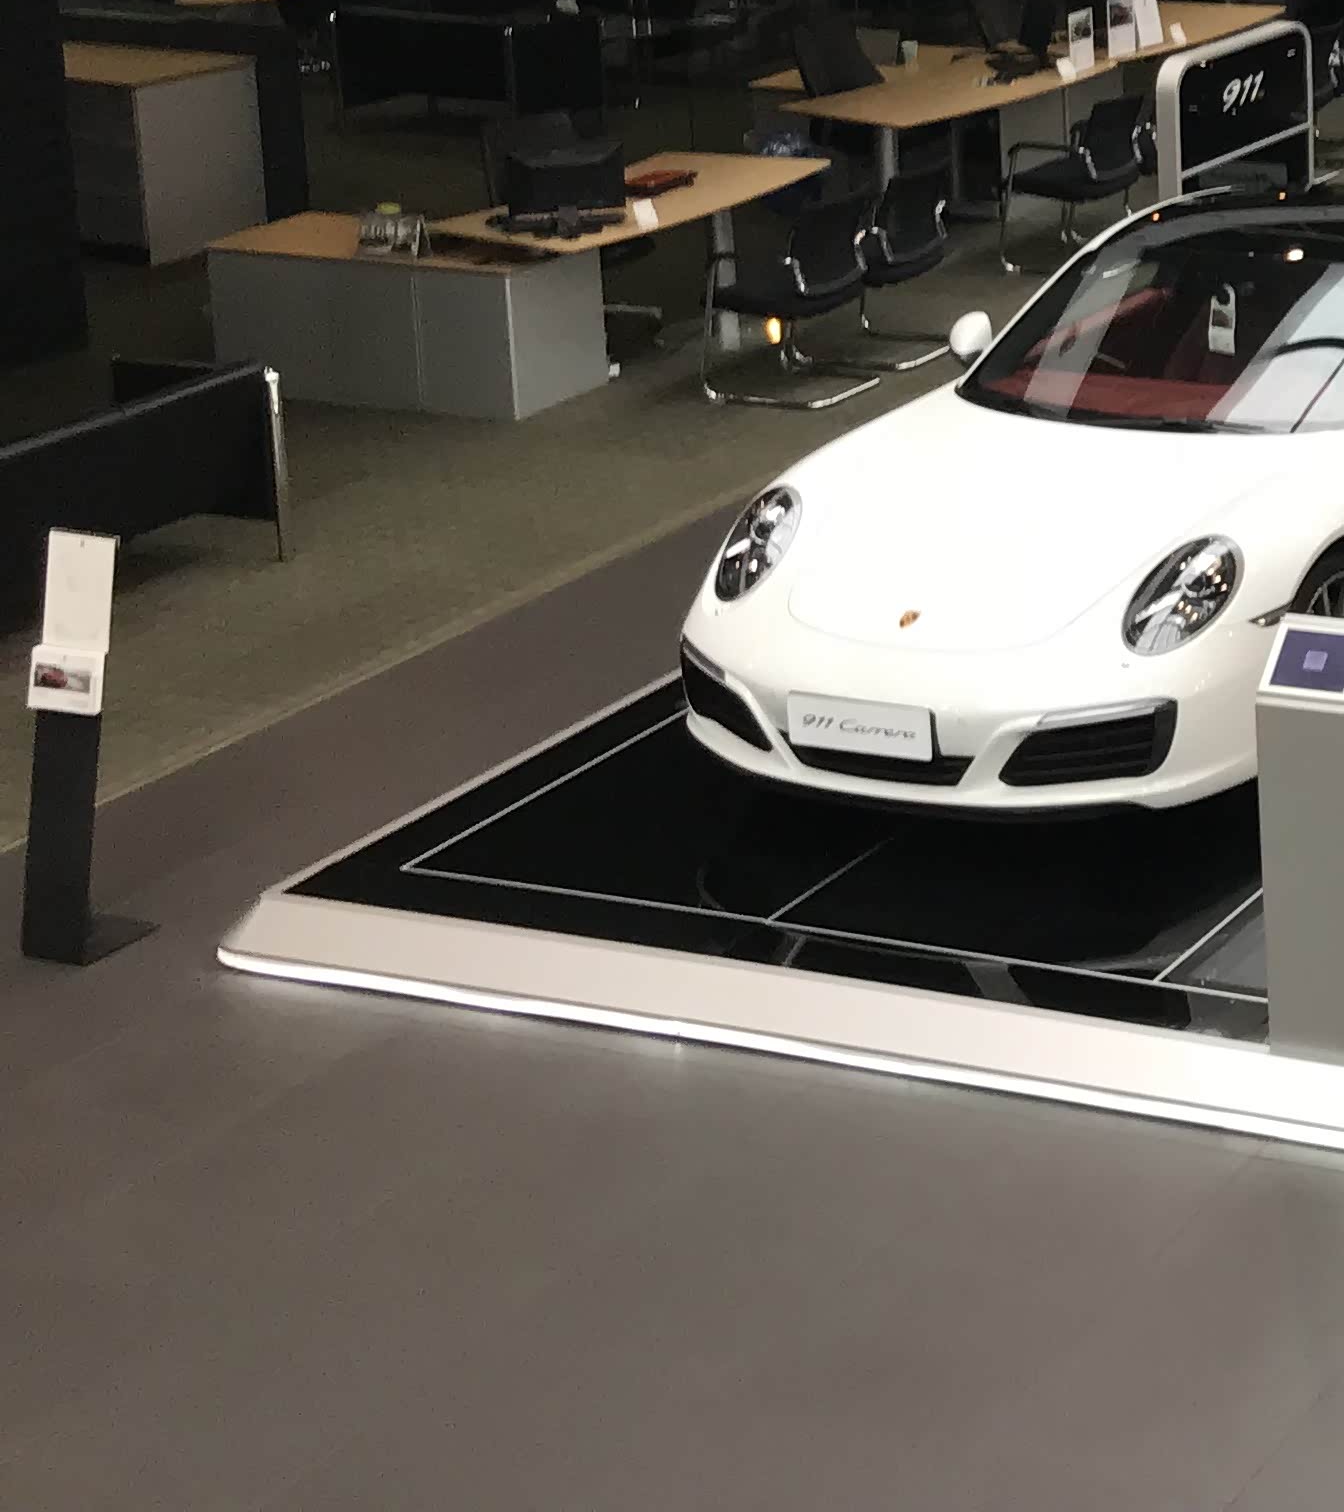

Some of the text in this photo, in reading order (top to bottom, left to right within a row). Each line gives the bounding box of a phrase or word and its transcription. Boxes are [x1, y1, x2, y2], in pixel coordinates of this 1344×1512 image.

[1222, 70, 1264, 112] 911
[802, 713, 916, 738] 911 Carrera
